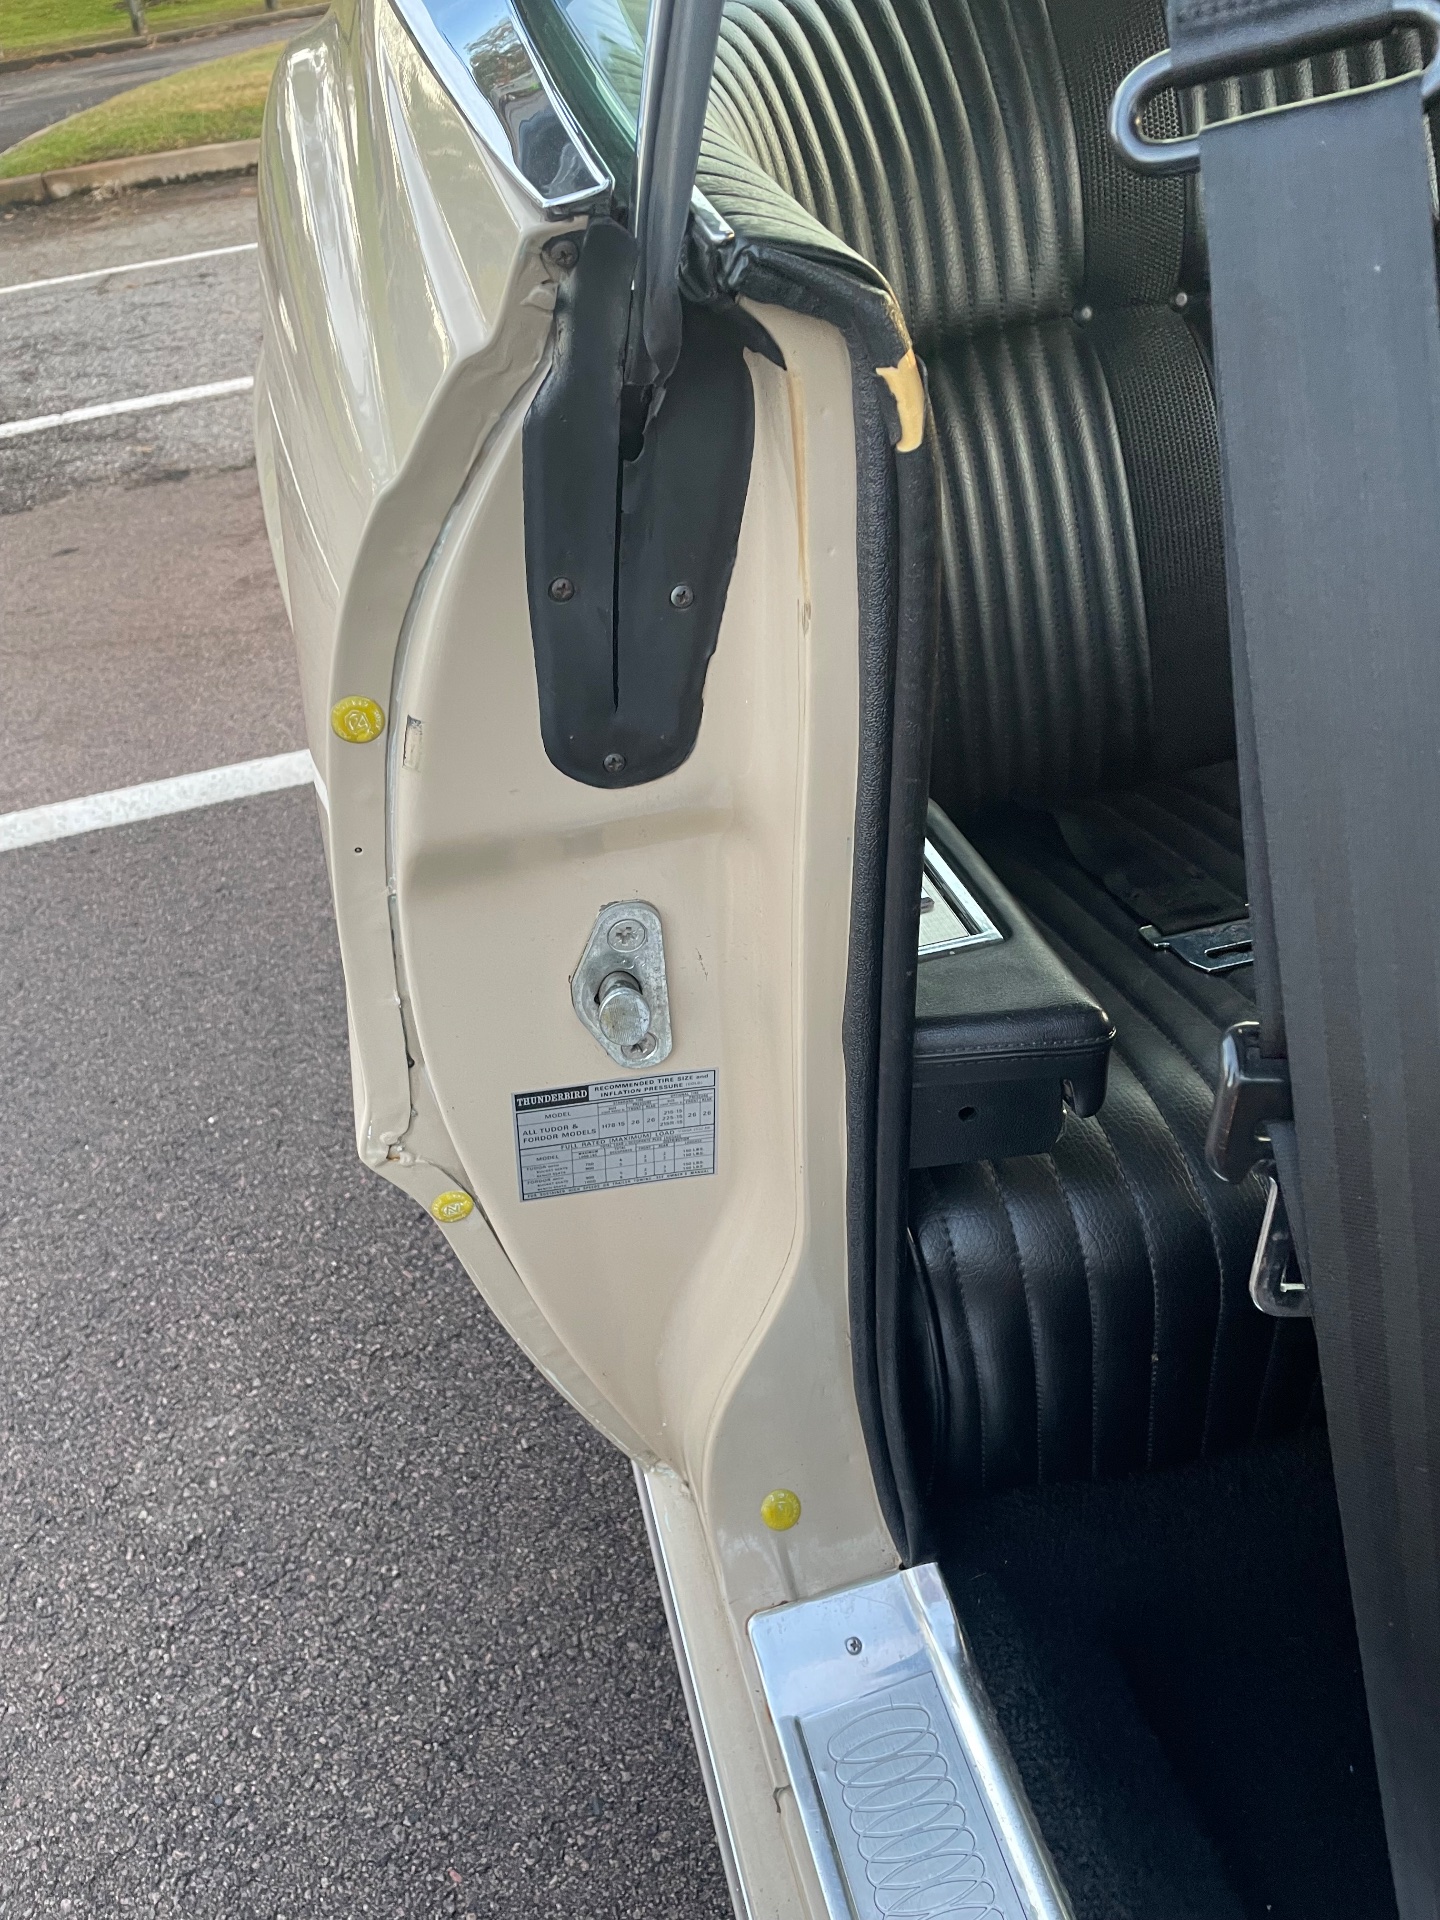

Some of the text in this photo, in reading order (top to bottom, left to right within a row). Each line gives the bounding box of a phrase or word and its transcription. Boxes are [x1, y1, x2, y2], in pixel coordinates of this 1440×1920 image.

[595, 1080, 654, 1092] RECOMMENDED
[601, 1088, 643, 1097] INFLATION
[644, 1083, 683, 1092] PRESSURE
[517, 1090, 587, 1106] THUNDERBIRD
[544, 1111, 571, 1119] MODEL
[541, 1125, 569, 1133] TUDOR
[523, 1129, 596, 1143] FORDOR MODELS
[610, 1132, 651, 1142] (MAXIMUM)
